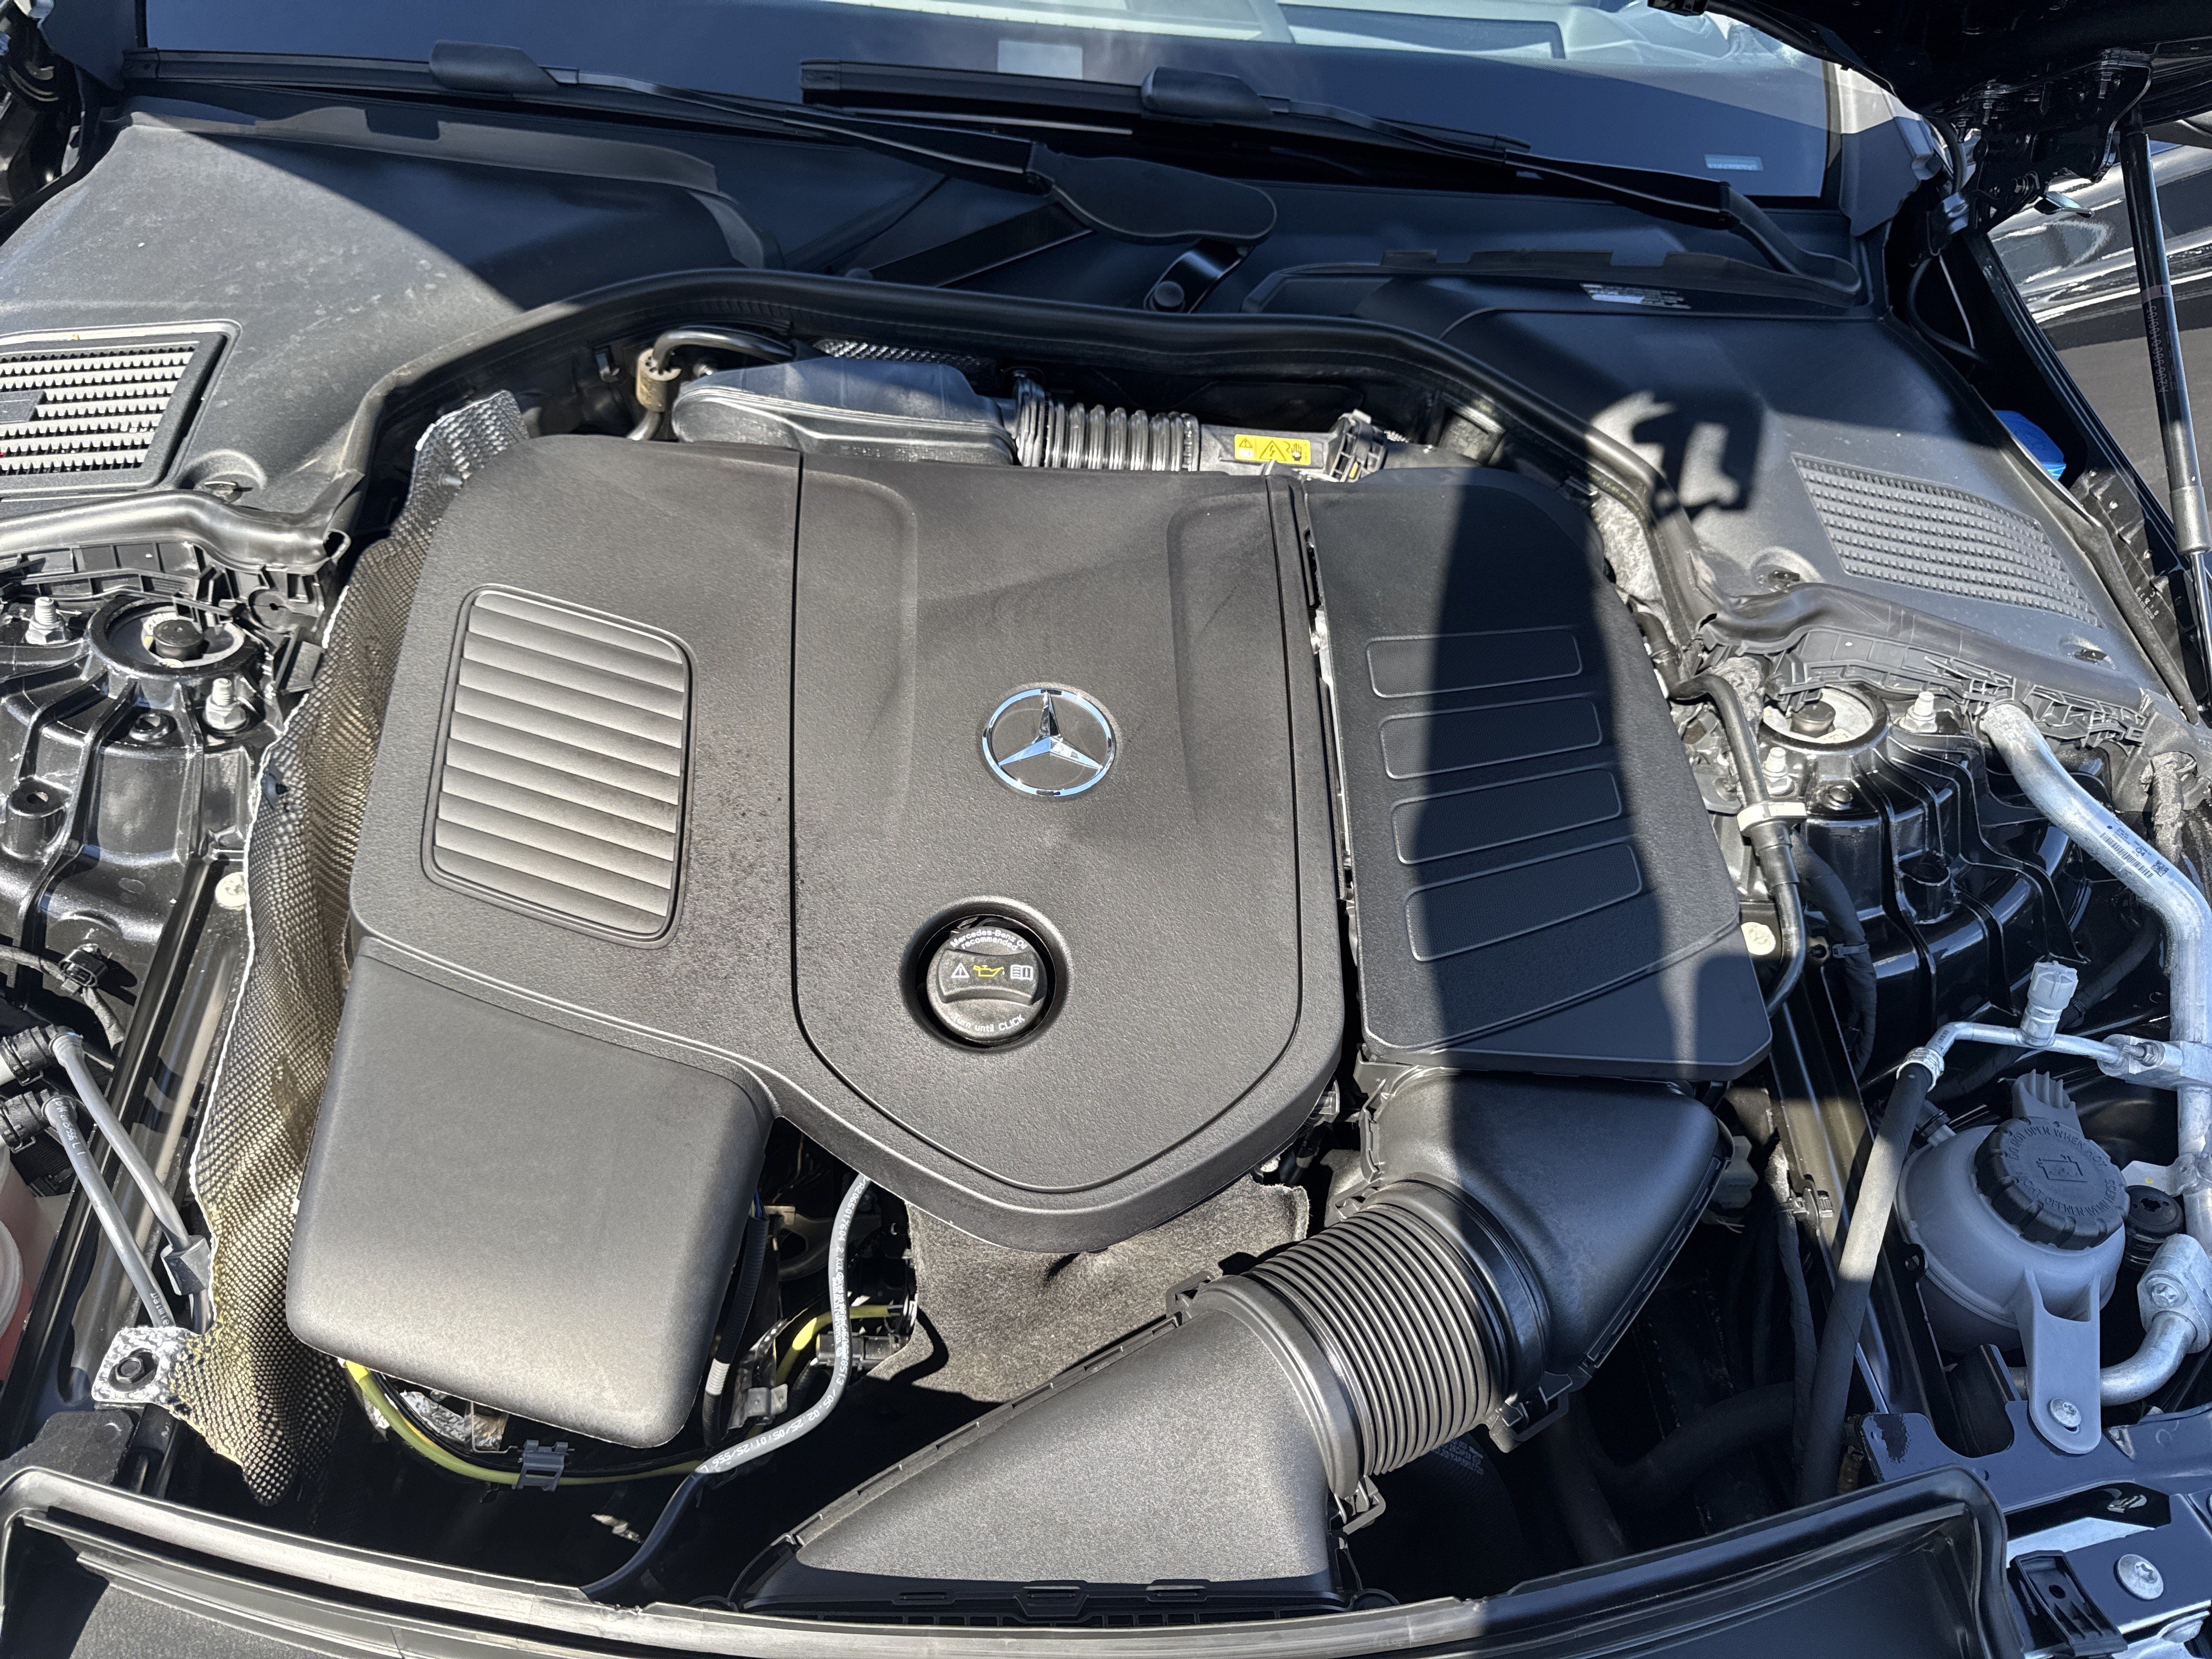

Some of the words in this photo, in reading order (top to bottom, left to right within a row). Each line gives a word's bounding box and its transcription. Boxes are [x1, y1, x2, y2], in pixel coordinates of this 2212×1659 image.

[950, 929, 1016, 947] Mercedes-Benz
[1017, 939, 1028, 950] Oil
[961, 936, 1018, 951] recommended
[952, 1012, 972, 1029] Turn
[974, 1024, 994, 1032] until
[998, 1014, 1025, 1031] CLICK
[2053, 1128, 2086, 1149] WHEN
